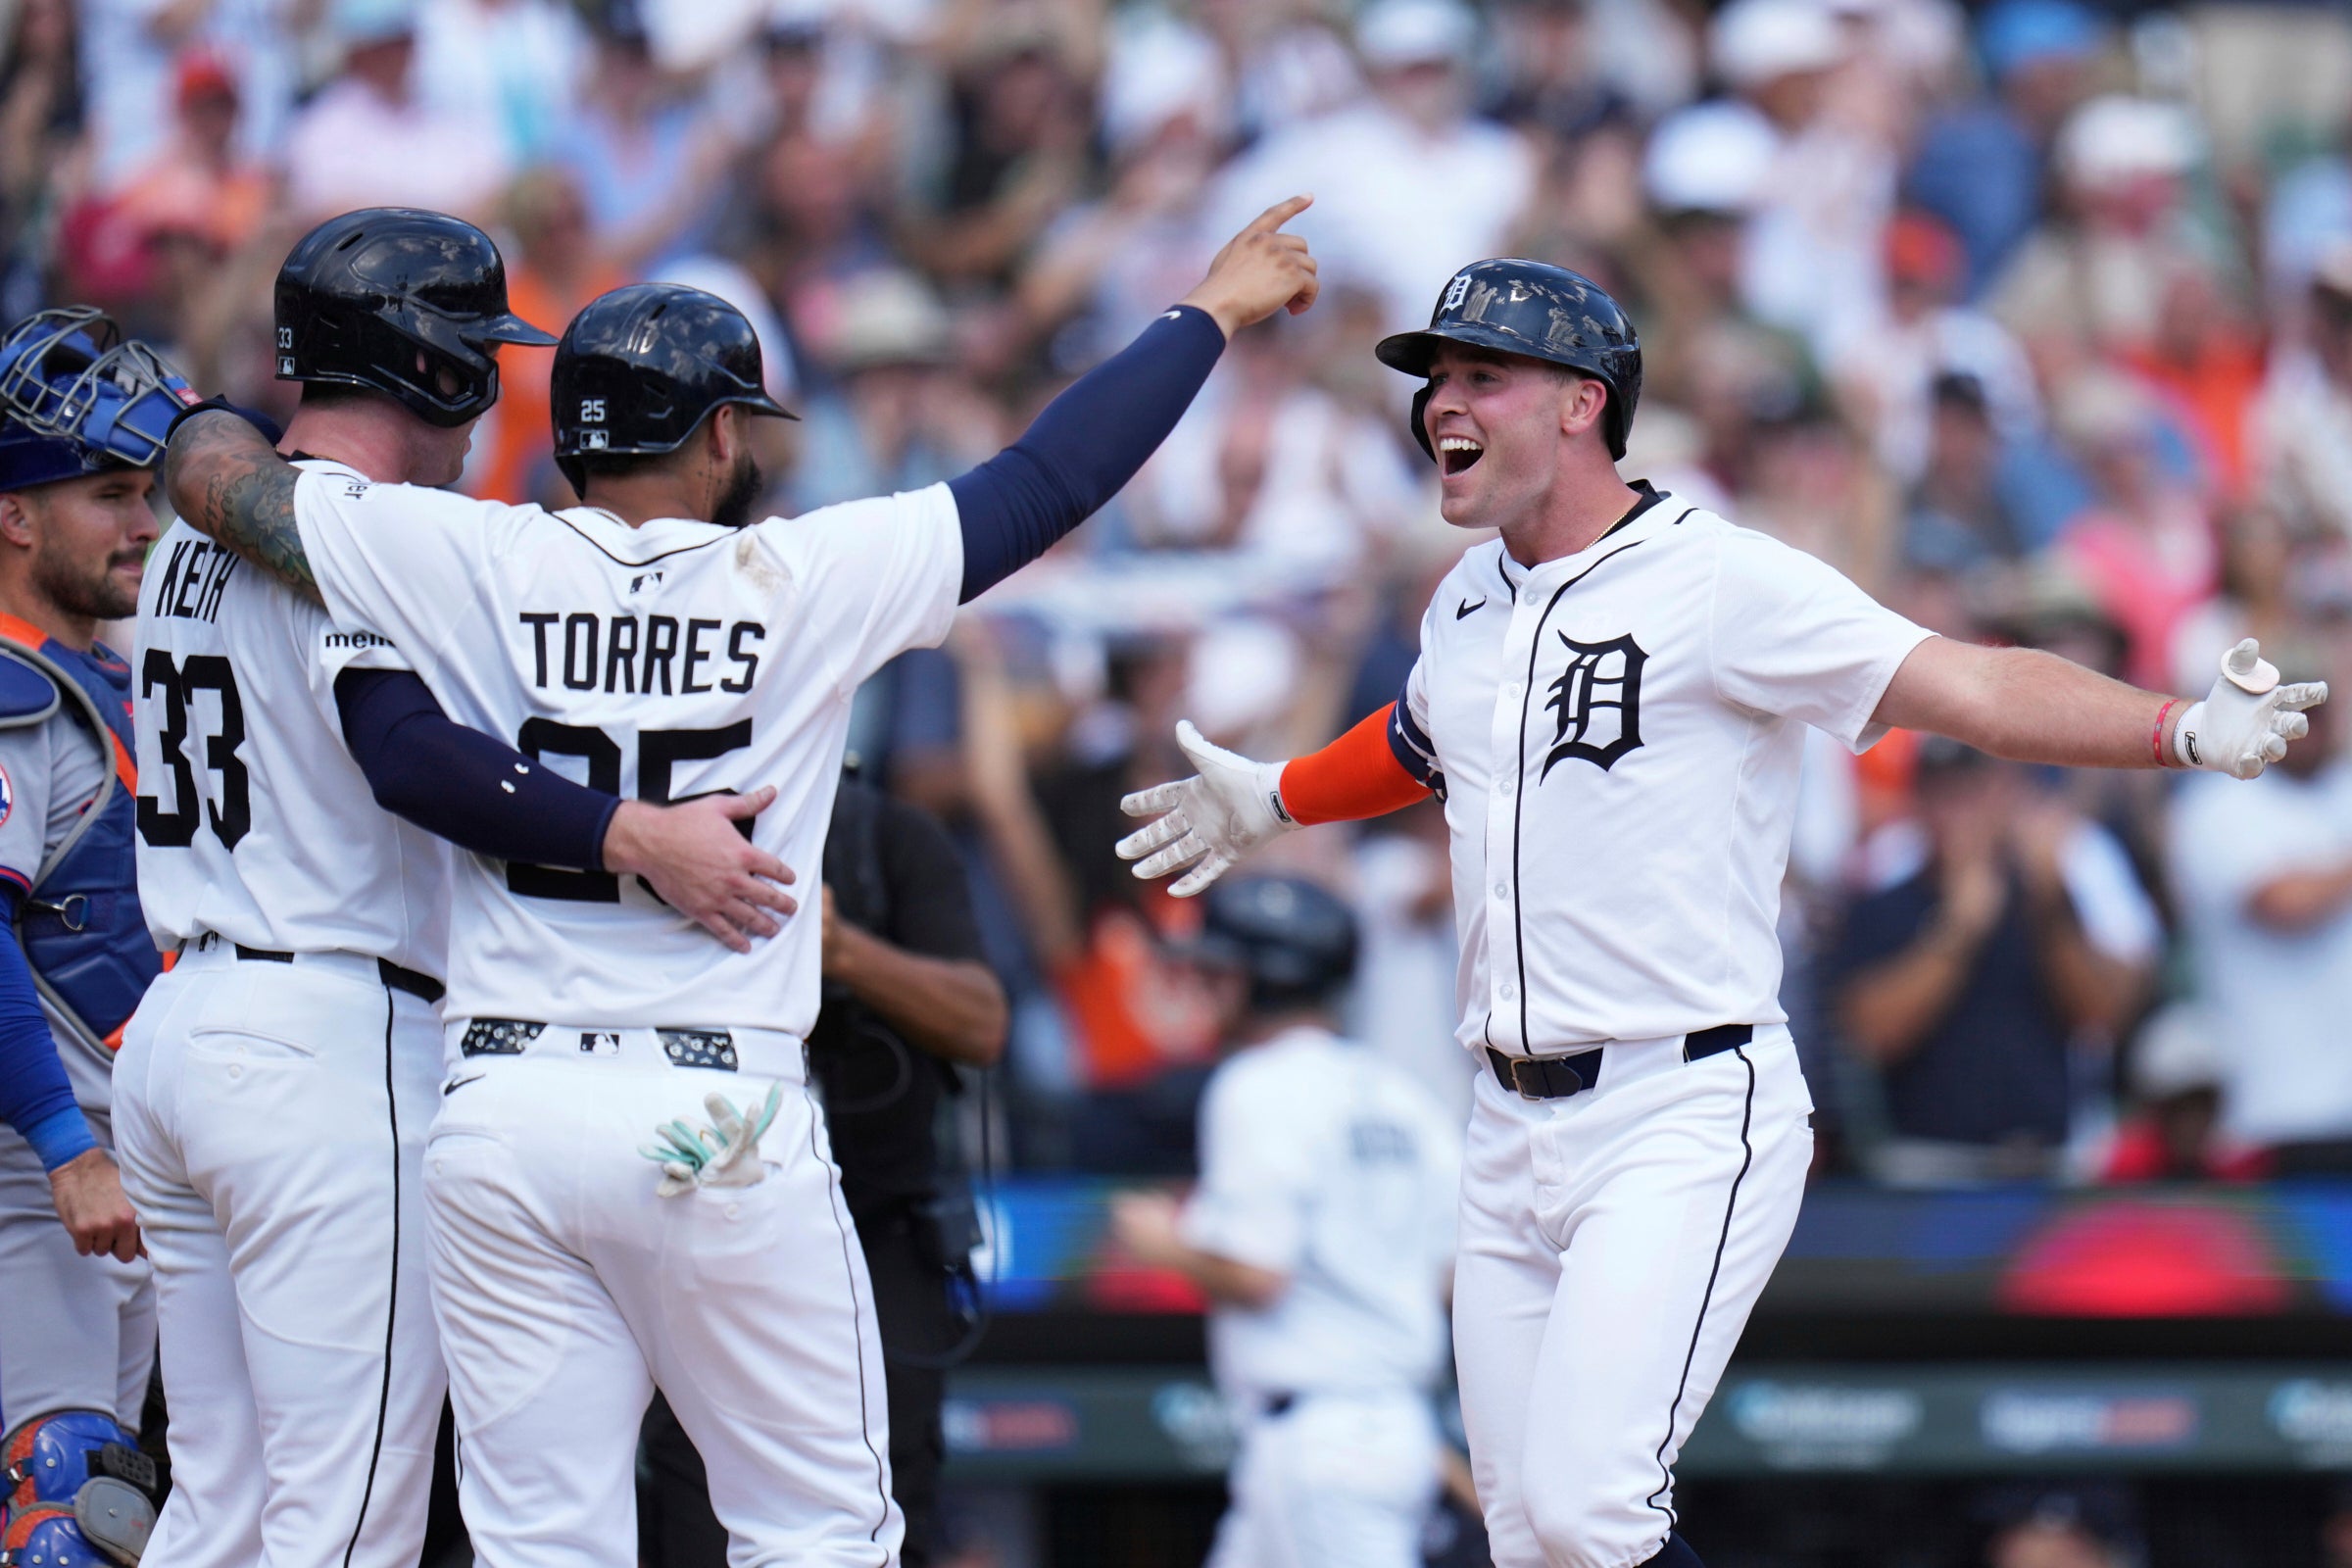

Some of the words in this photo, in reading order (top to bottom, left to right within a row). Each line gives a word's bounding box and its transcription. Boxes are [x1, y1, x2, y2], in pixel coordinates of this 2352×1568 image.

[278, 327, 292, 349] 33
[581, 400, 605, 422] 25
[155, 539, 240, 624] KETH
[519, 612, 766, 696] TORRES
[1540, 629, 1650, 787] D
[136, 648, 251, 854] 33
